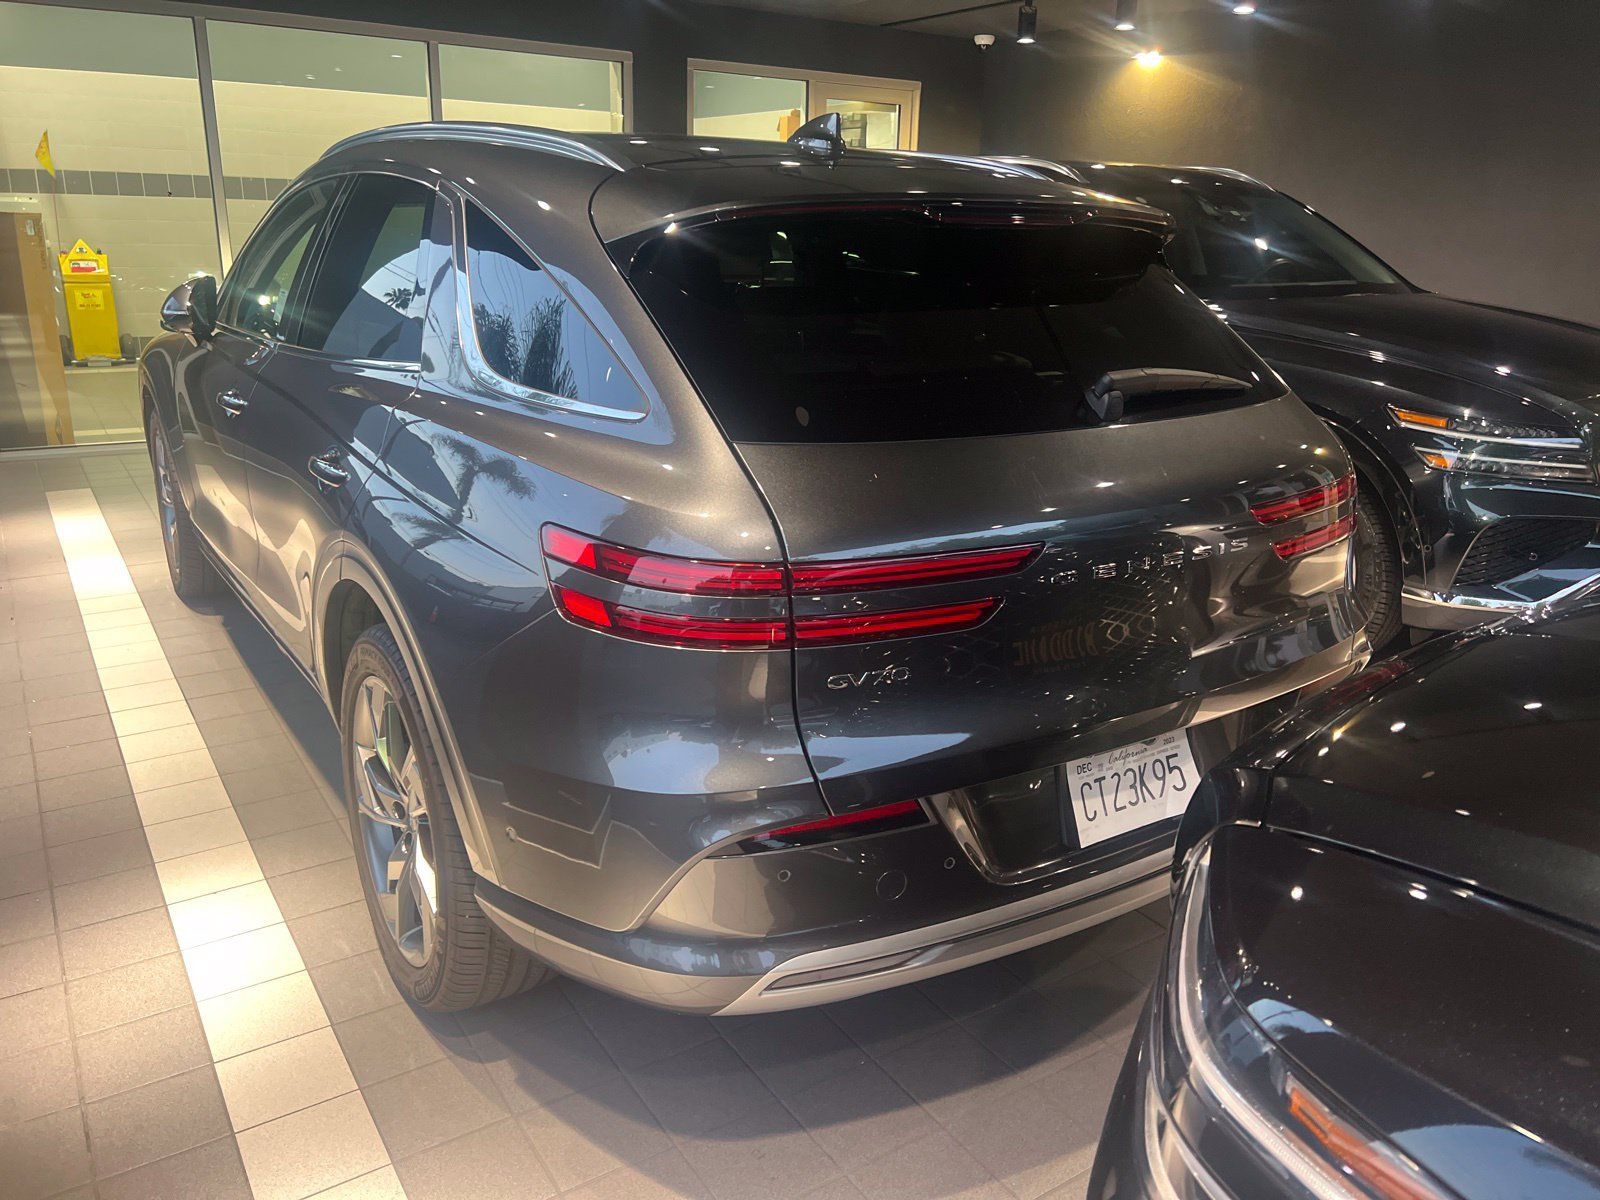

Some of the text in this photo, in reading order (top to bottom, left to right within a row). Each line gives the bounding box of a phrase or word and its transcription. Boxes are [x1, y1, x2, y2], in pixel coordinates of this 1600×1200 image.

[1050, 538, 1249, 584] GENESIS
[827, 666, 909, 689] GV70
[1108, 747, 1147, 765] California
[1077, 762, 1092, 775] DEC
[1080, 753, 1187, 821] CT23K95
